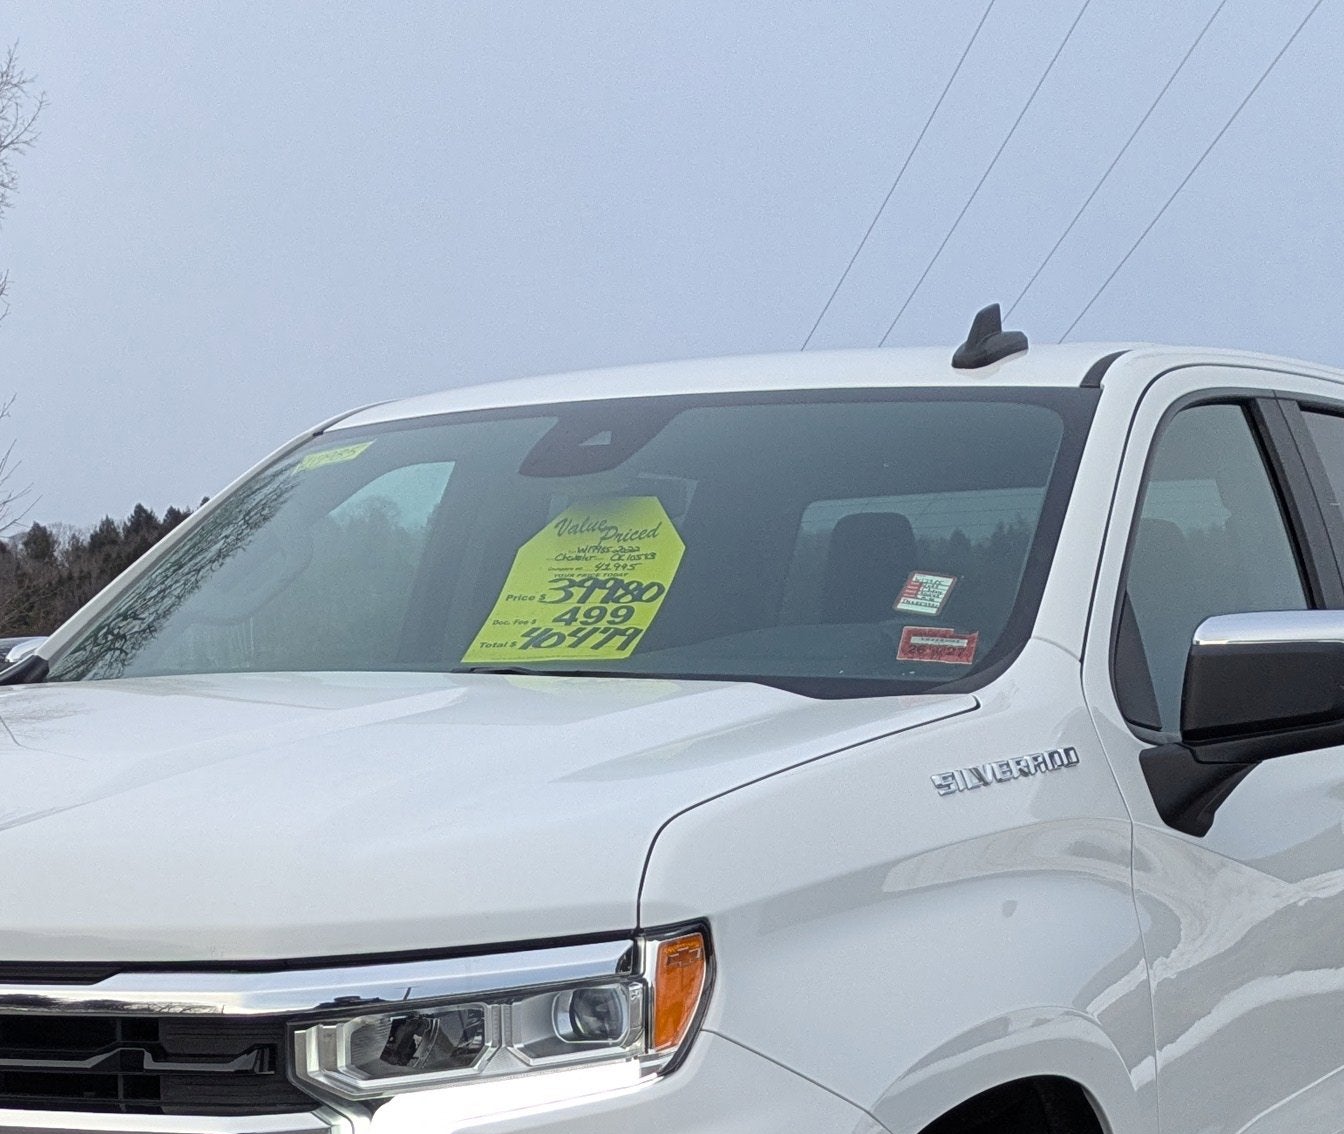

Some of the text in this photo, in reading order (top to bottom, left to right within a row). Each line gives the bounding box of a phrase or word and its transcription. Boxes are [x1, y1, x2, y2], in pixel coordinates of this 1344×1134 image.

[554, 516, 662, 546] Value Priced
[505, 593, 535, 601] Price
[552, 605, 635, 626] 499
[479, 640, 508, 648] Total
[518, 626, 644, 651] 40479
[930, 746, 1080, 796] SILVERADO
